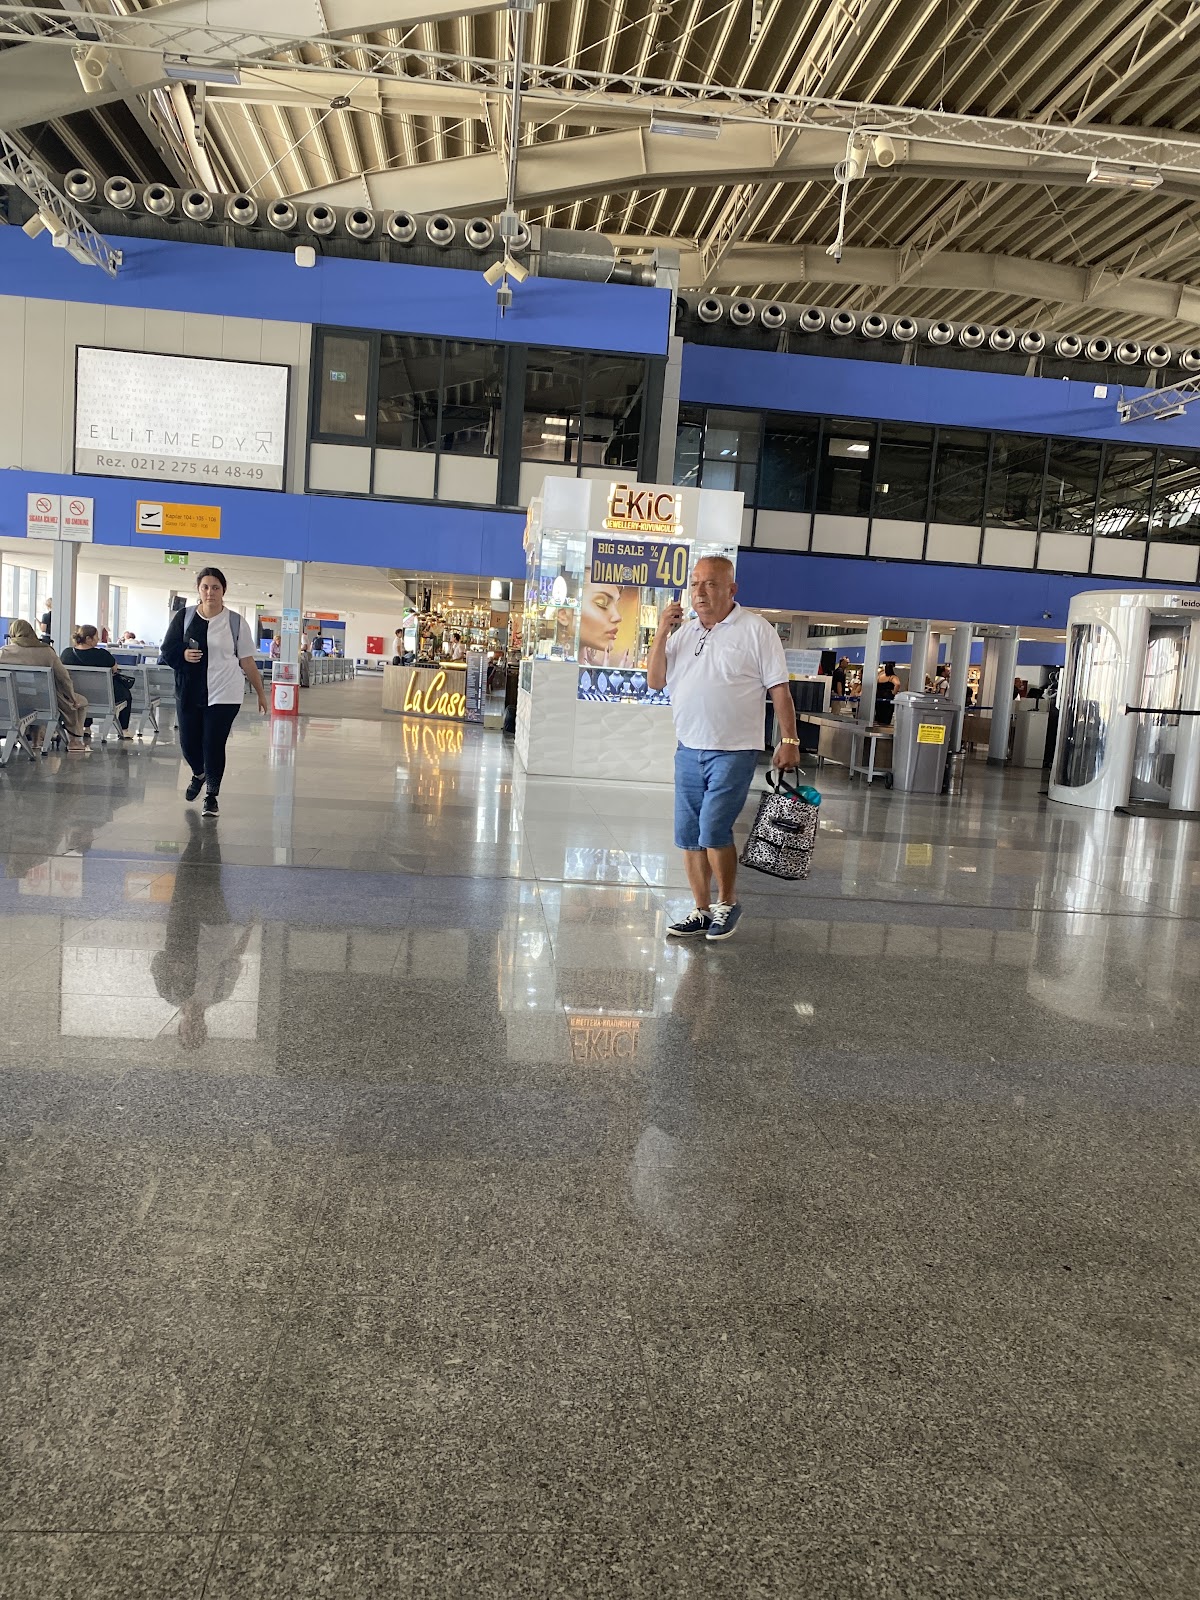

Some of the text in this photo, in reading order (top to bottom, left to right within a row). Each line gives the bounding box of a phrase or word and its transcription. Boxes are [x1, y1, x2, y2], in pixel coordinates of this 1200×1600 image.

[97, 455, 264, 480] Rez. 0212 275 44 48-49
[597, 543, 645, 557] BIG SALE
[403, 670, 422, 712] La
